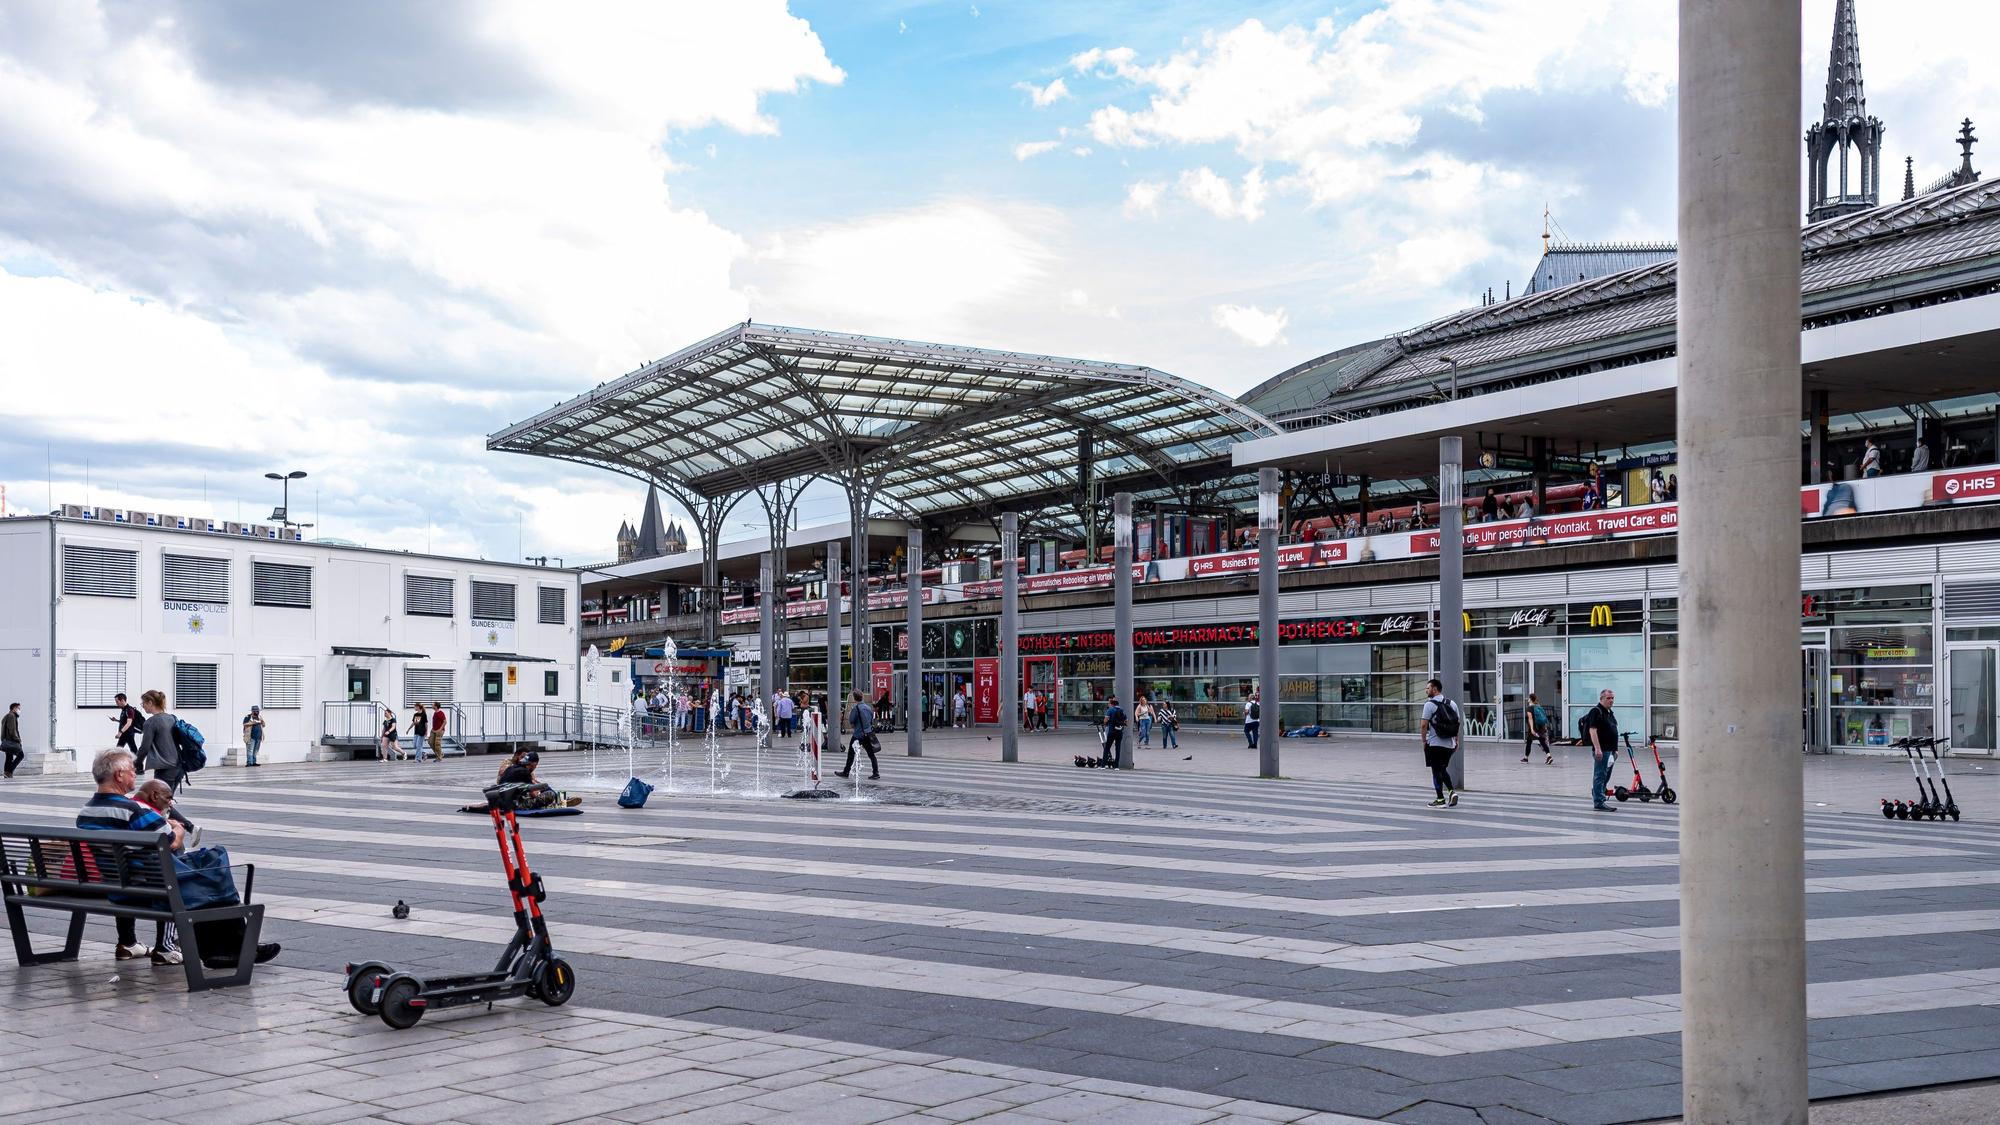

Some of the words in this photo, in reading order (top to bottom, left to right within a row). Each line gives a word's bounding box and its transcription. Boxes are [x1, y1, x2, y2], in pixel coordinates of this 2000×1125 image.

[1324, 473, 1331, 485] B
[1963, 477, 1996, 490] HRS
[1430, 537, 1440, 547] Ru
[1467, 533, 1479, 543] die
[1481, 531, 1496, 542] Uhr
[1499, 525, 1551, 542] persönlicher
[1554, 521, 1592, 534] Kontakt.
[1597, 516, 1628, 530] Travel
[1630, 514, 1655, 527] Care:
[1660, 511, 1677, 523] ein
[1200, 561, 1213, 570] HRS
[1221, 557, 1247, 569] Business
[1286, 552, 1304, 562] Level.
[1320, 547, 1341, 559] hrs.de
[164, 601, 228, 613] BUNDESPOLIZEI
[471, 620, 515, 629] BUNDESPOLIZEI
[1172, 625, 1244, 642] PHARMACY
[1278, 620, 1347, 639] POTHEKE
[1076, 660, 1086, 672] 20
[1087, 660, 1111, 673] JAHRE
[1282, 679, 1316, 693] JAHRE
